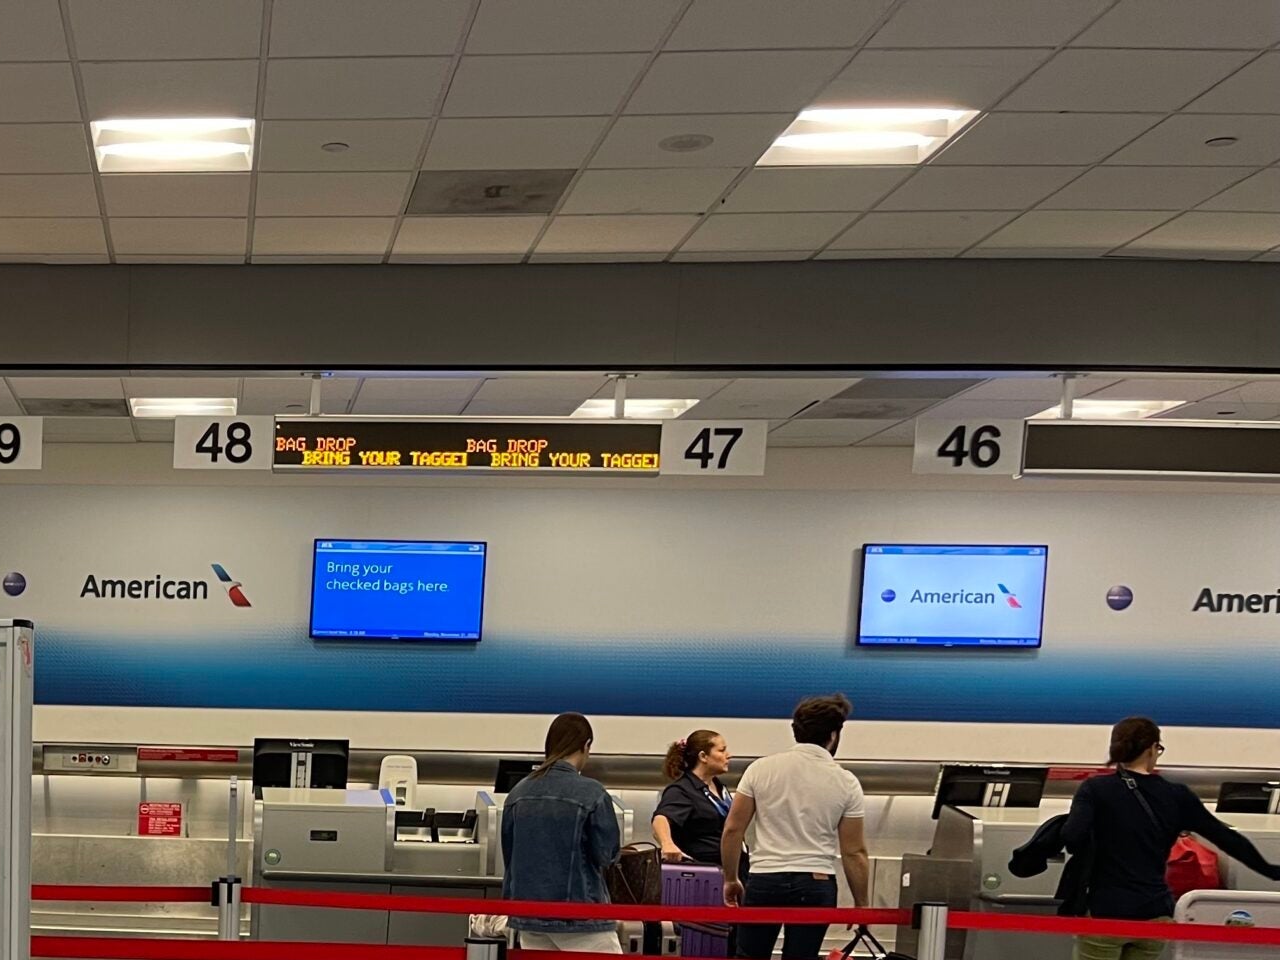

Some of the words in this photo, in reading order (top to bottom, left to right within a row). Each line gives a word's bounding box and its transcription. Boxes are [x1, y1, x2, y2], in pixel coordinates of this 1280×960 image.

[194, 422, 253, 463] 48
[276, 437, 306, 451] BAG
[317, 437, 356, 451] DROP
[466, 439, 497, 453] BAG
[507, 439, 548, 453] DROP
[684, 427, 743, 469] 47
[937, 425, 1002, 468] 46
[302, 451, 350, 465] BRING
[359, 451, 401, 466] YOUR
[490, 452, 539, 467] BRING
[549, 453, 591, 467] YOUR
[327, 562, 360, 576] Bring
[363, 564, 393, 576] your
[81, 574, 209, 602] American
[326, 579, 380, 591] checked
[383, 580, 414, 594] bags
[910, 589, 995, 604] American
